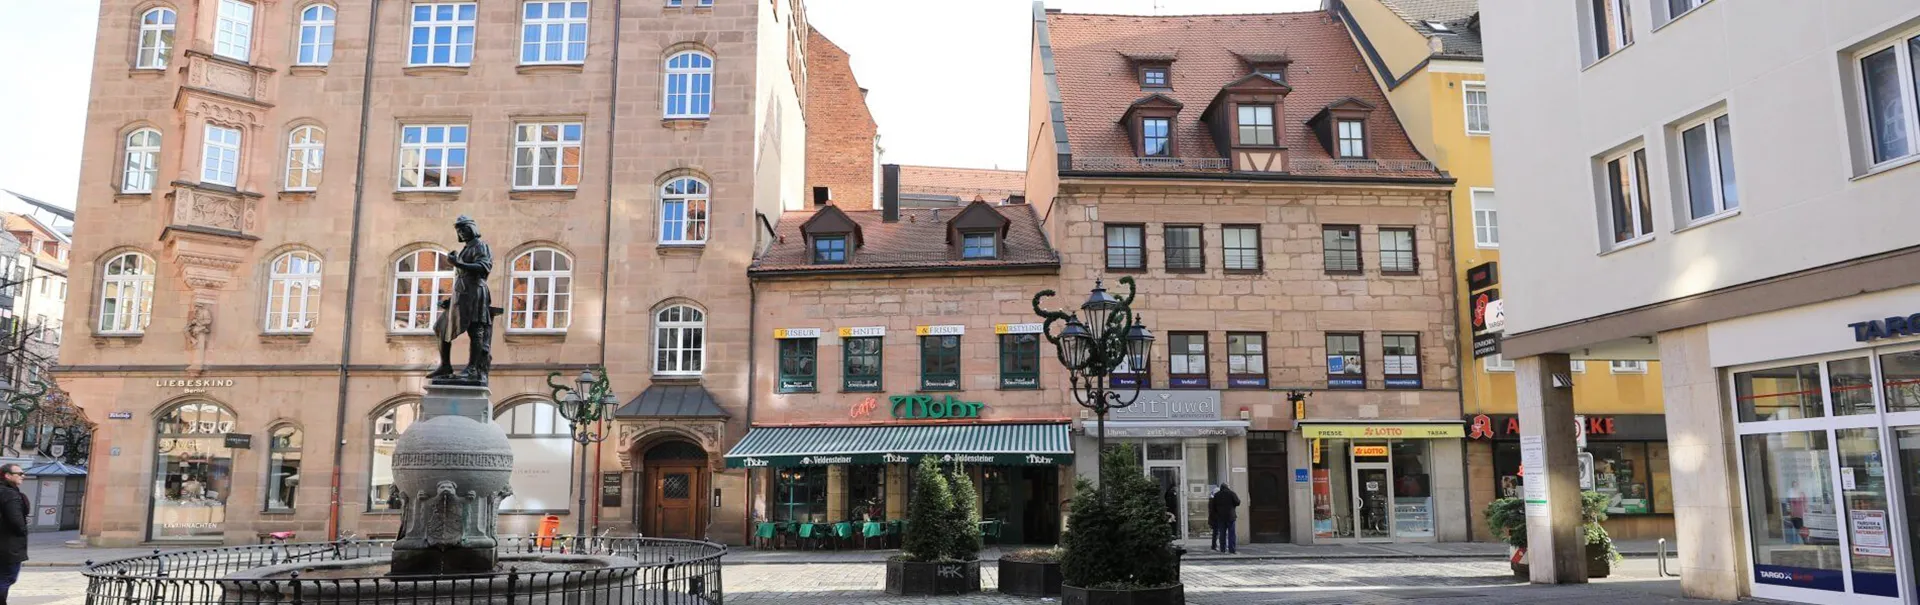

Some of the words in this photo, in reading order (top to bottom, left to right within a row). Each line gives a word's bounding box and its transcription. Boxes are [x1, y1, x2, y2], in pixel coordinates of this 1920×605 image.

[780, 328, 815, 337] FRISEUR
[842, 327, 881, 335] SCHNITT
[929, 326, 958, 334] FRISUR
[996, 324, 1042, 333] HAIRSTYLING
[1375, 428, 1402, 436] LOTTO
[813, 456, 852, 464] Veldensteiner
[1760, 571, 1785, 579] TARGO
